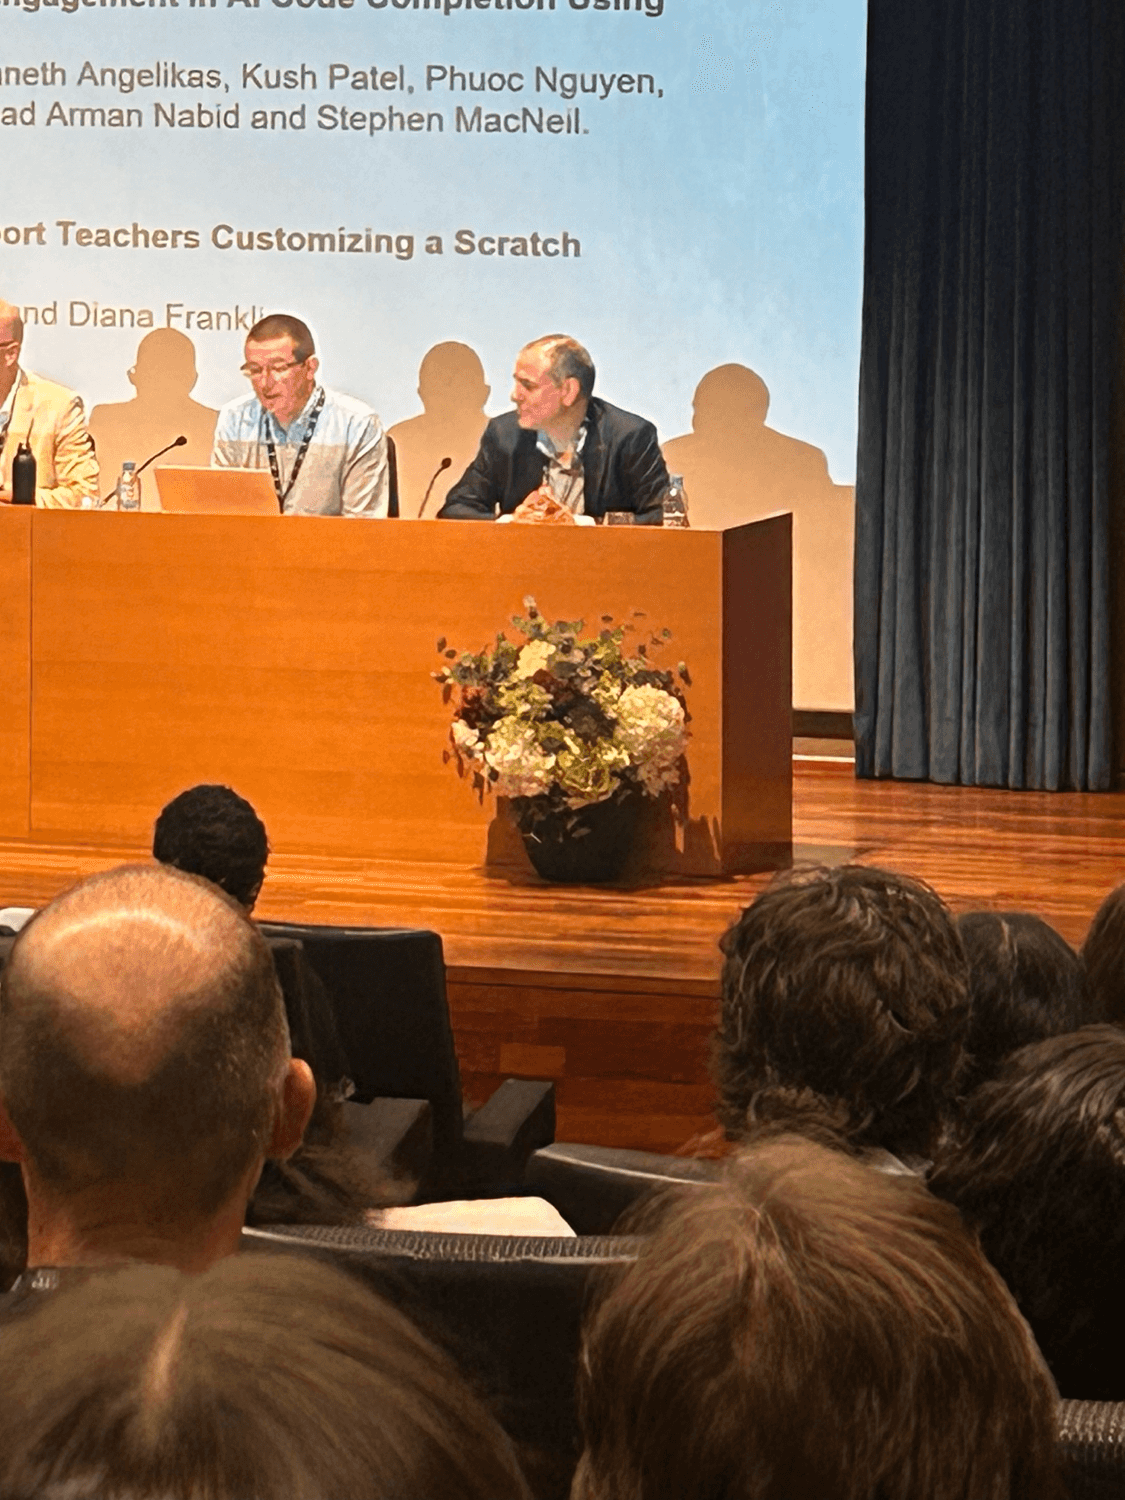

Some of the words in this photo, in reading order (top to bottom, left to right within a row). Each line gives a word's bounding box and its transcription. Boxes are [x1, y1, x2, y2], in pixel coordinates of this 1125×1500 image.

[77, 61, 229, 93] Angelikas,
[243, 63, 317, 90] Kush
[329, 64, 414, 94] Patel,
[426, 65, 524, 92] Phuoc
[536, 66, 663, 100] Nguyen,
[46, 101, 142, 127] Arman
[154, 103, 239, 129] Nabid
[251, 103, 306, 130] and
[317, 104, 443, 137] Stephen
[456, 106, 589, 134] MacNeil.
[56, 221, 200, 248] Teachers
[211, 224, 414, 260] Customizing
[425, 236, 443, 255] a
[454, 230, 580, 257] Scratch
[18, 301, 58, 325] nd
[70, 301, 153, 328] Diana
